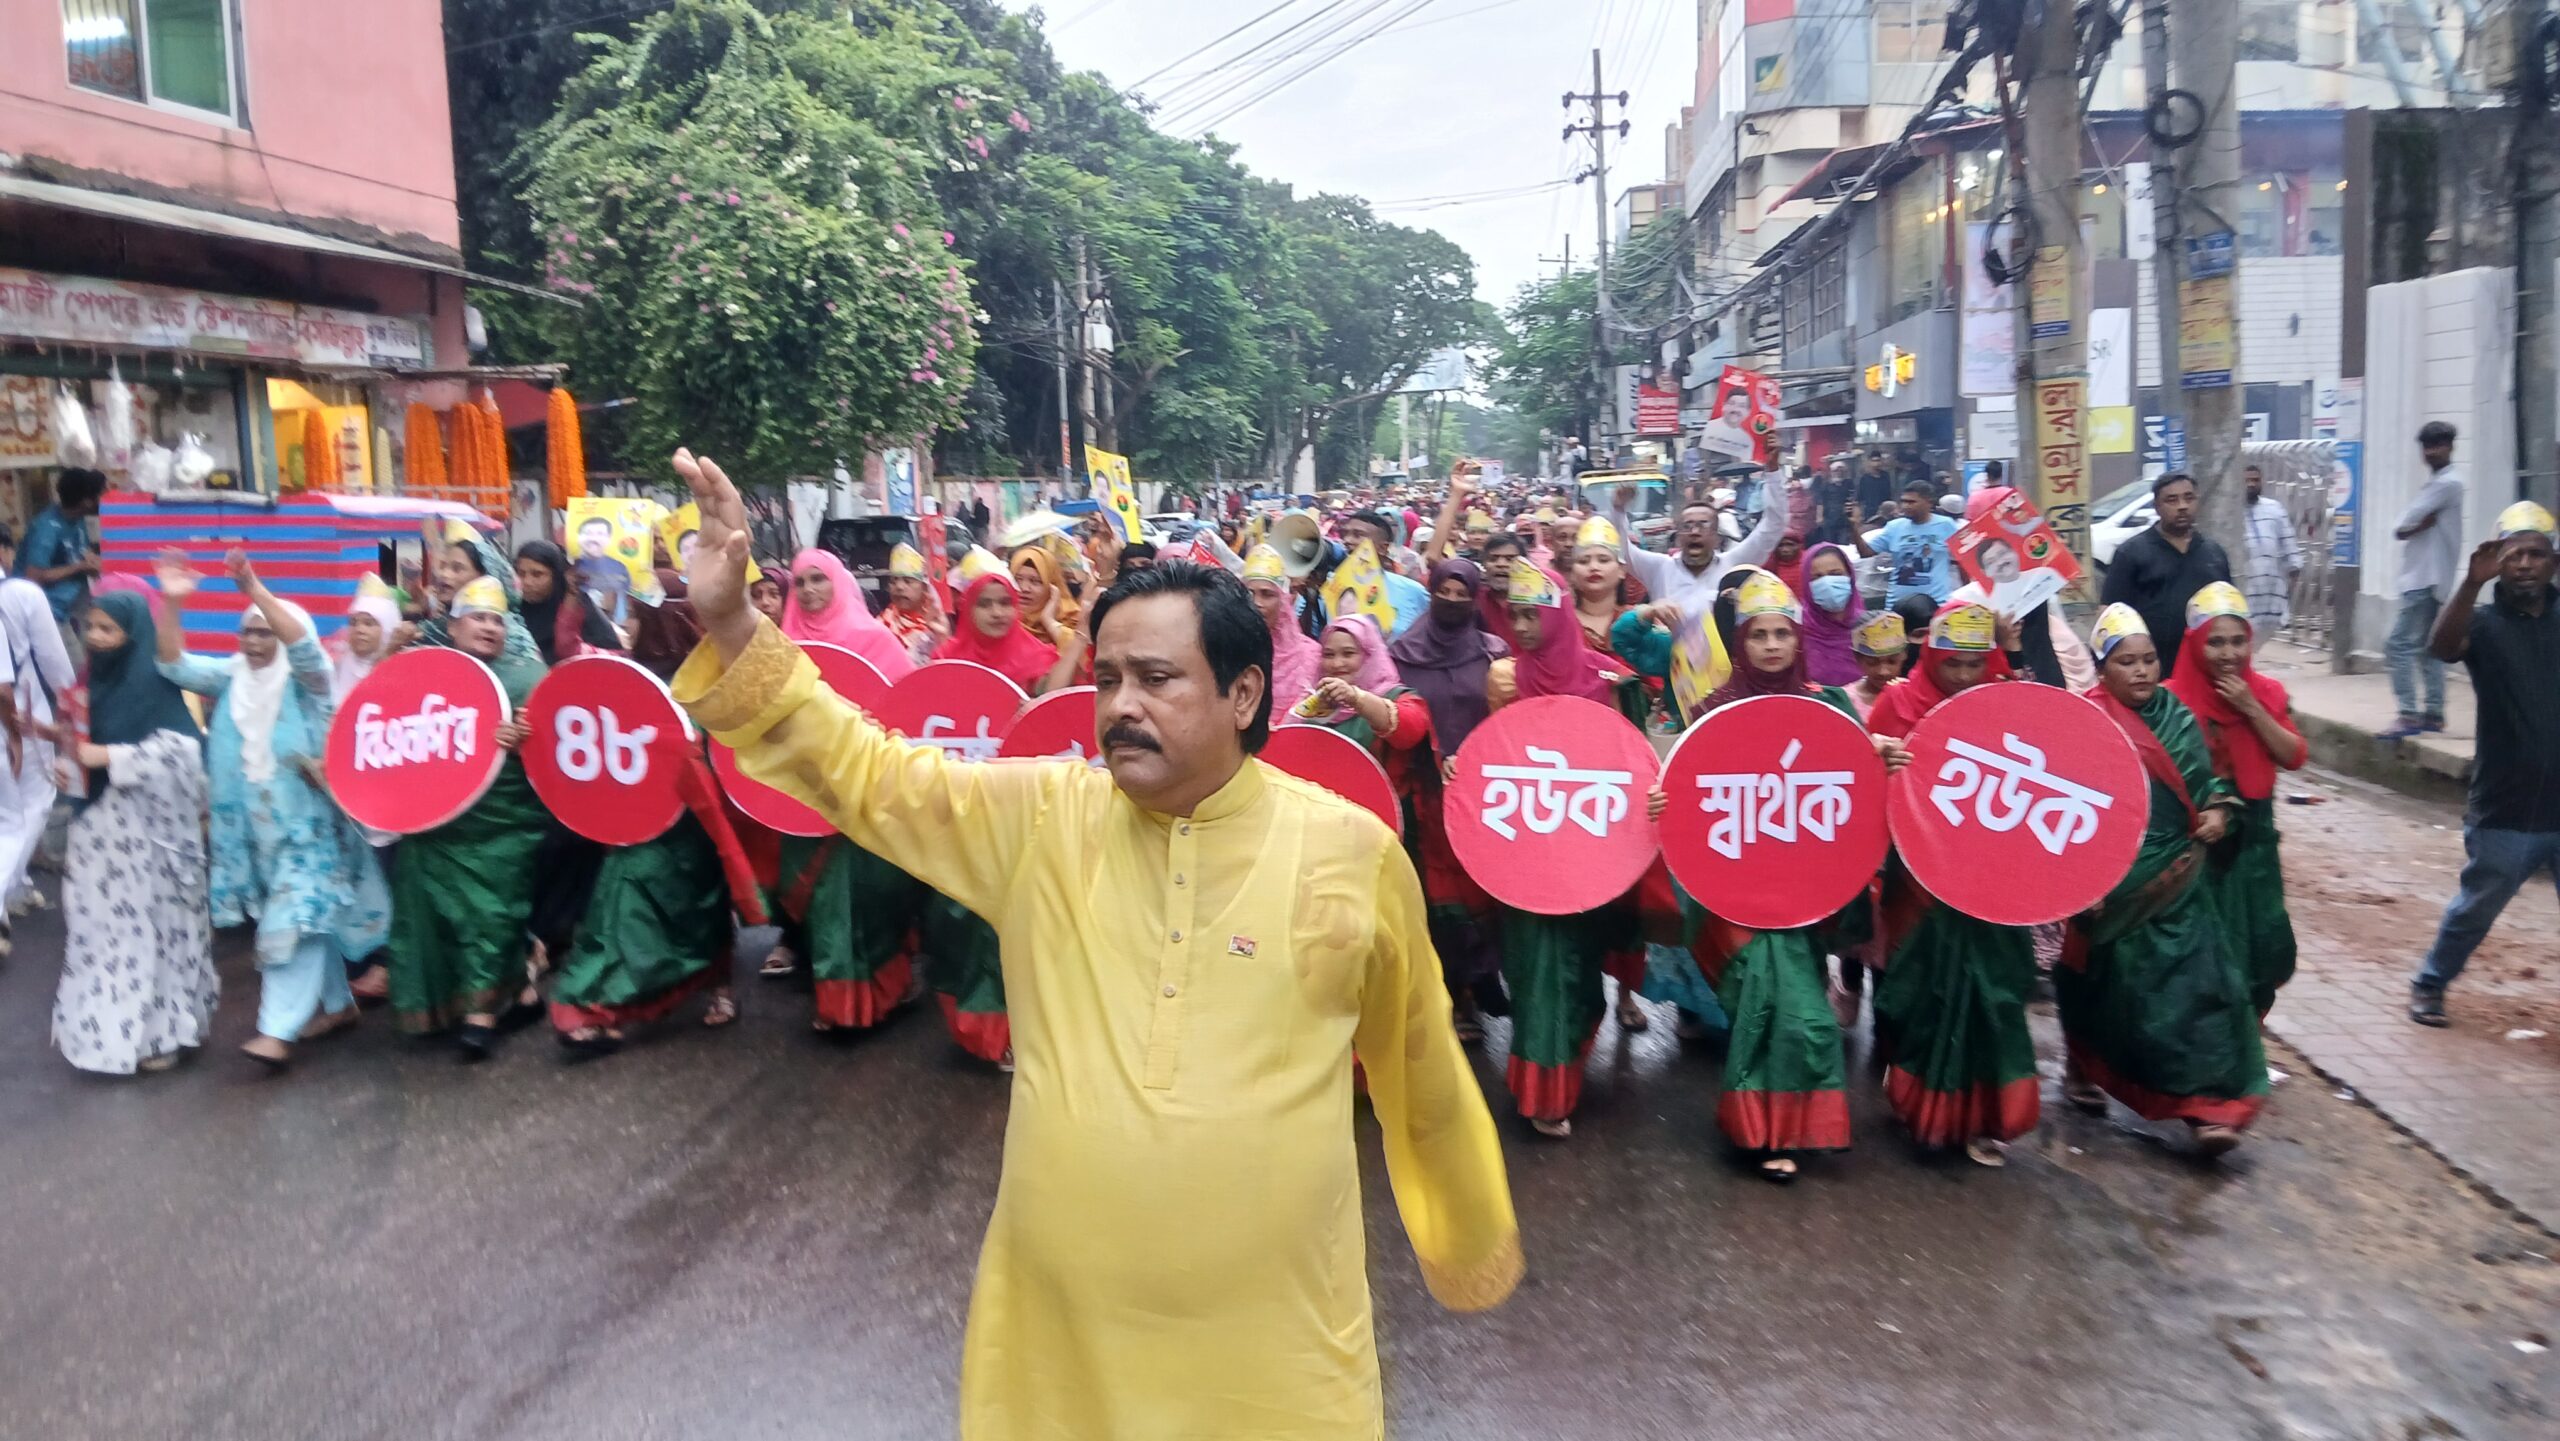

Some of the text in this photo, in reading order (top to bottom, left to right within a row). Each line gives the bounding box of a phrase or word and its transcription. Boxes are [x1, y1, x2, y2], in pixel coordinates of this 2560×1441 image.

[555, 704, 658, 785] ৪৮
[1481, 746, 1633, 841] হউক
[1929, 732, 2114, 856] হউক
[1696, 738, 1855, 860] স্বার্থক
